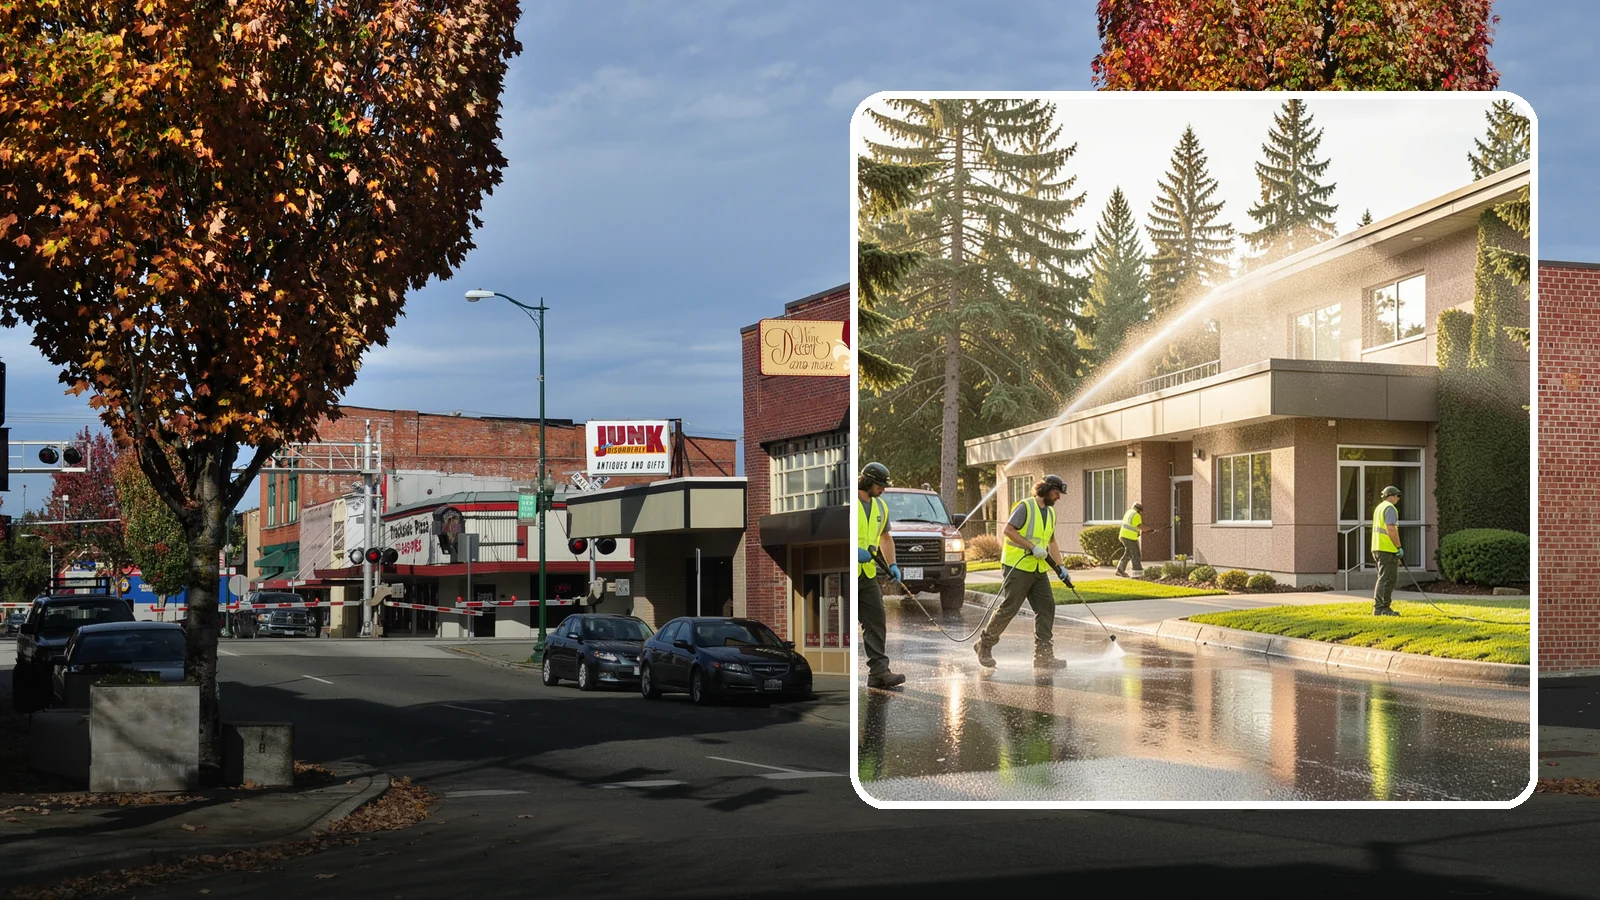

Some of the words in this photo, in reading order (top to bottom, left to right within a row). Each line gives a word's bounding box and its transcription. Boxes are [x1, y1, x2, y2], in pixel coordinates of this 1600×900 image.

[595, 425, 666, 457] JUNK
[607, 446, 646, 454] DISORDERLY
[597, 461, 628, 470] ANTIQUES
[631, 461, 644, 470] AND
[646, 460, 665, 469] GIFTS
